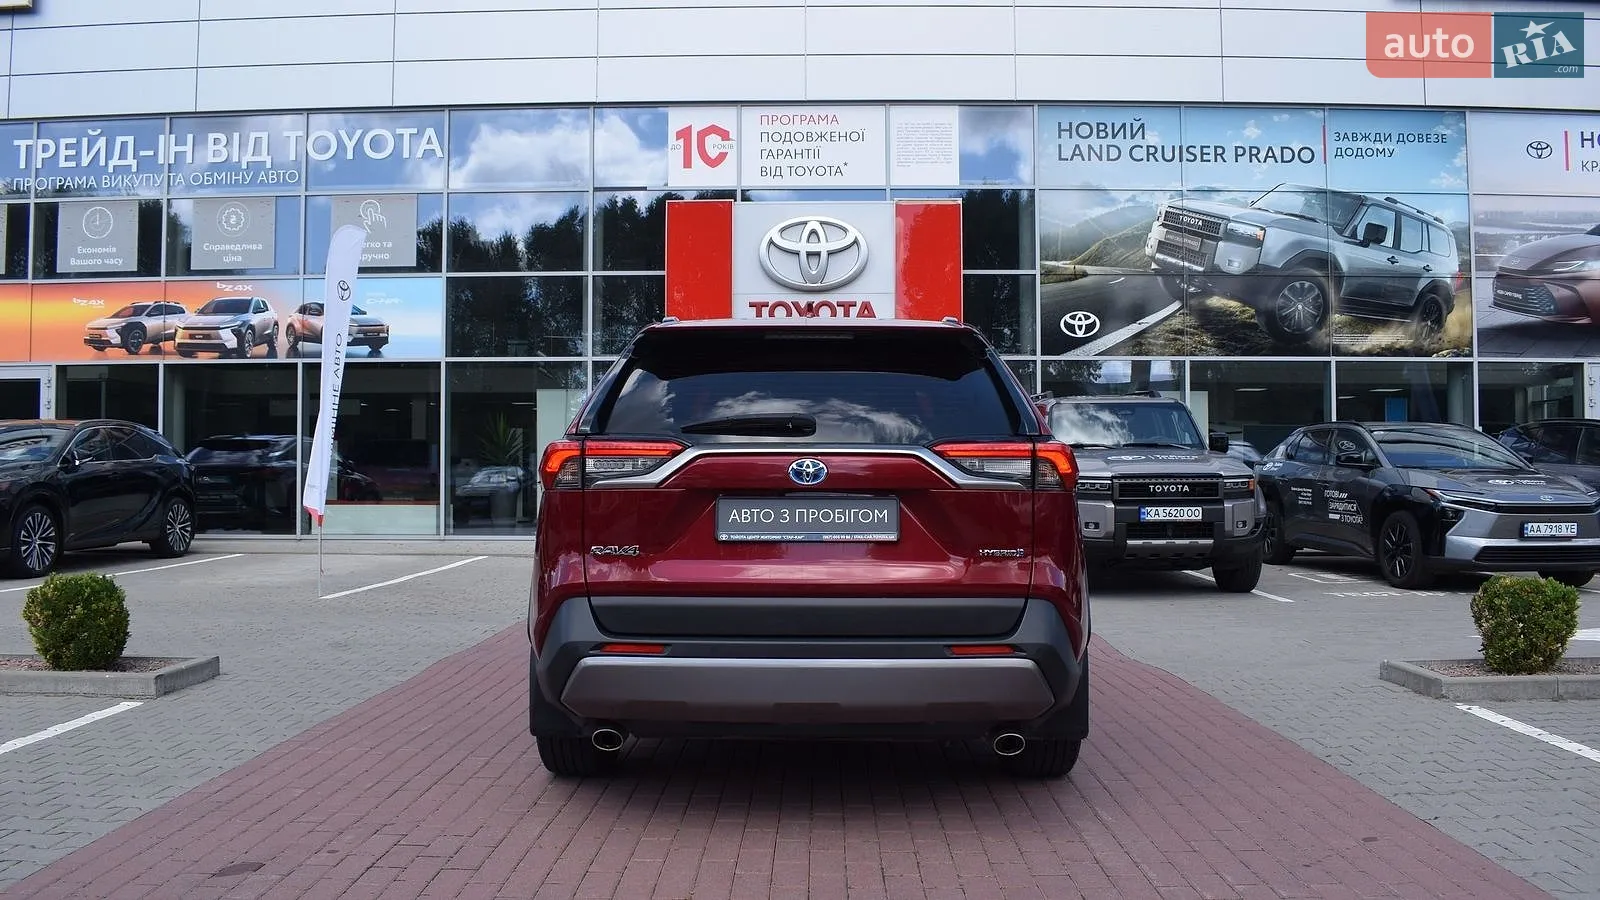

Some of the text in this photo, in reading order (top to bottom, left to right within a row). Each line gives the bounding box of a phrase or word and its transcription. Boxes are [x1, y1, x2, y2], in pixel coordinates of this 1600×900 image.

[760, 114, 840, 126] ПРОГРАМА
[1057, 118, 1146, 141] НОВИЙ
[760, 128, 866, 145] ПОДОВЖЕНОЇ
[1334, 131, 1448, 144] ЗАВЖДИ ДОВЕЗЕ
[1580, 131, 1600, 149] Н
[13, 127, 446, 174] ТРЕЙД-ІН ВІД TOYOTA
[760, 146, 822, 160] ГАРАНТІЇ
[1057, 143, 1315, 166] LAND CRUISER PRADO
[1334, 147, 1396, 160] ДОДОМУ
[1581, 160, 1600, 172] КР
[760, 166, 784, 179] ВІД
[13, 169, 300, 192] ПРОГРАМА ВИКУПУ ТА ОБМІНУ АВТО
[1179, 214, 1203, 226] TOYOTA
[77, 246, 117, 254] Економія
[203, 242, 263, 252] Справедлива
[103, 258, 124, 266] часу
[223, 253, 242, 264] ціна
[360, 253, 390, 262] ручно
[748, 300, 877, 318] TOYOTA
[1148, 484, 1190, 493] TOYOTA
[728, 509, 888, 523] АВТО З ПРОБІГОМ
[1146, 508, 1161, 518] KA
[1162, 508, 1185, 518] 5620
[1529, 524, 1542, 534] AA
[1543, 524, 1563, 534] 7918
[590, 545, 640, 556] RAV4
[979, 549, 1017, 557] HYBRID
